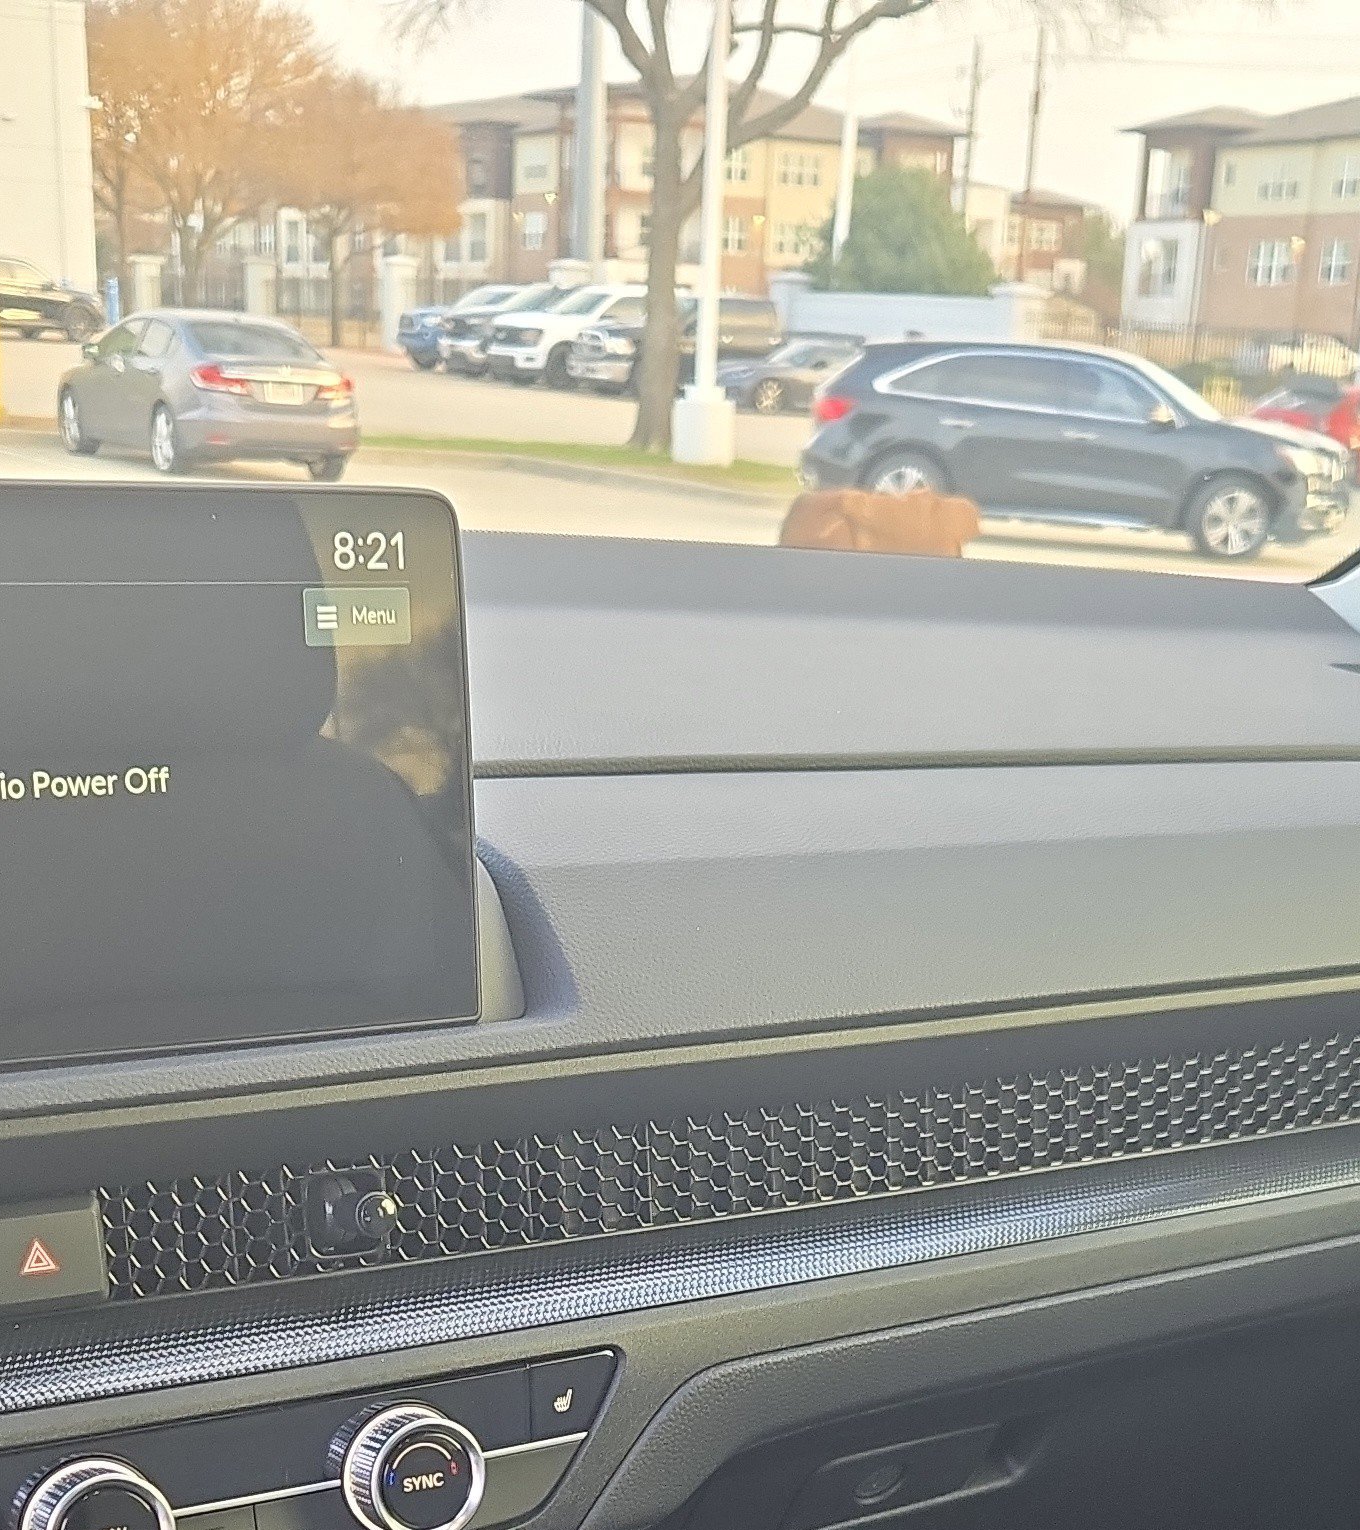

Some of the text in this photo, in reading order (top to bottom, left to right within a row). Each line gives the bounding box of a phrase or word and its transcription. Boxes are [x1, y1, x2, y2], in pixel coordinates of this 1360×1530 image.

[334, 531, 405, 570] 8:21
[352, 605, 396, 625] Menu
[32, 770, 118, 799] Power
[124, 766, 170, 795] Off
[403, 1472, 445, 1493] SYNC
